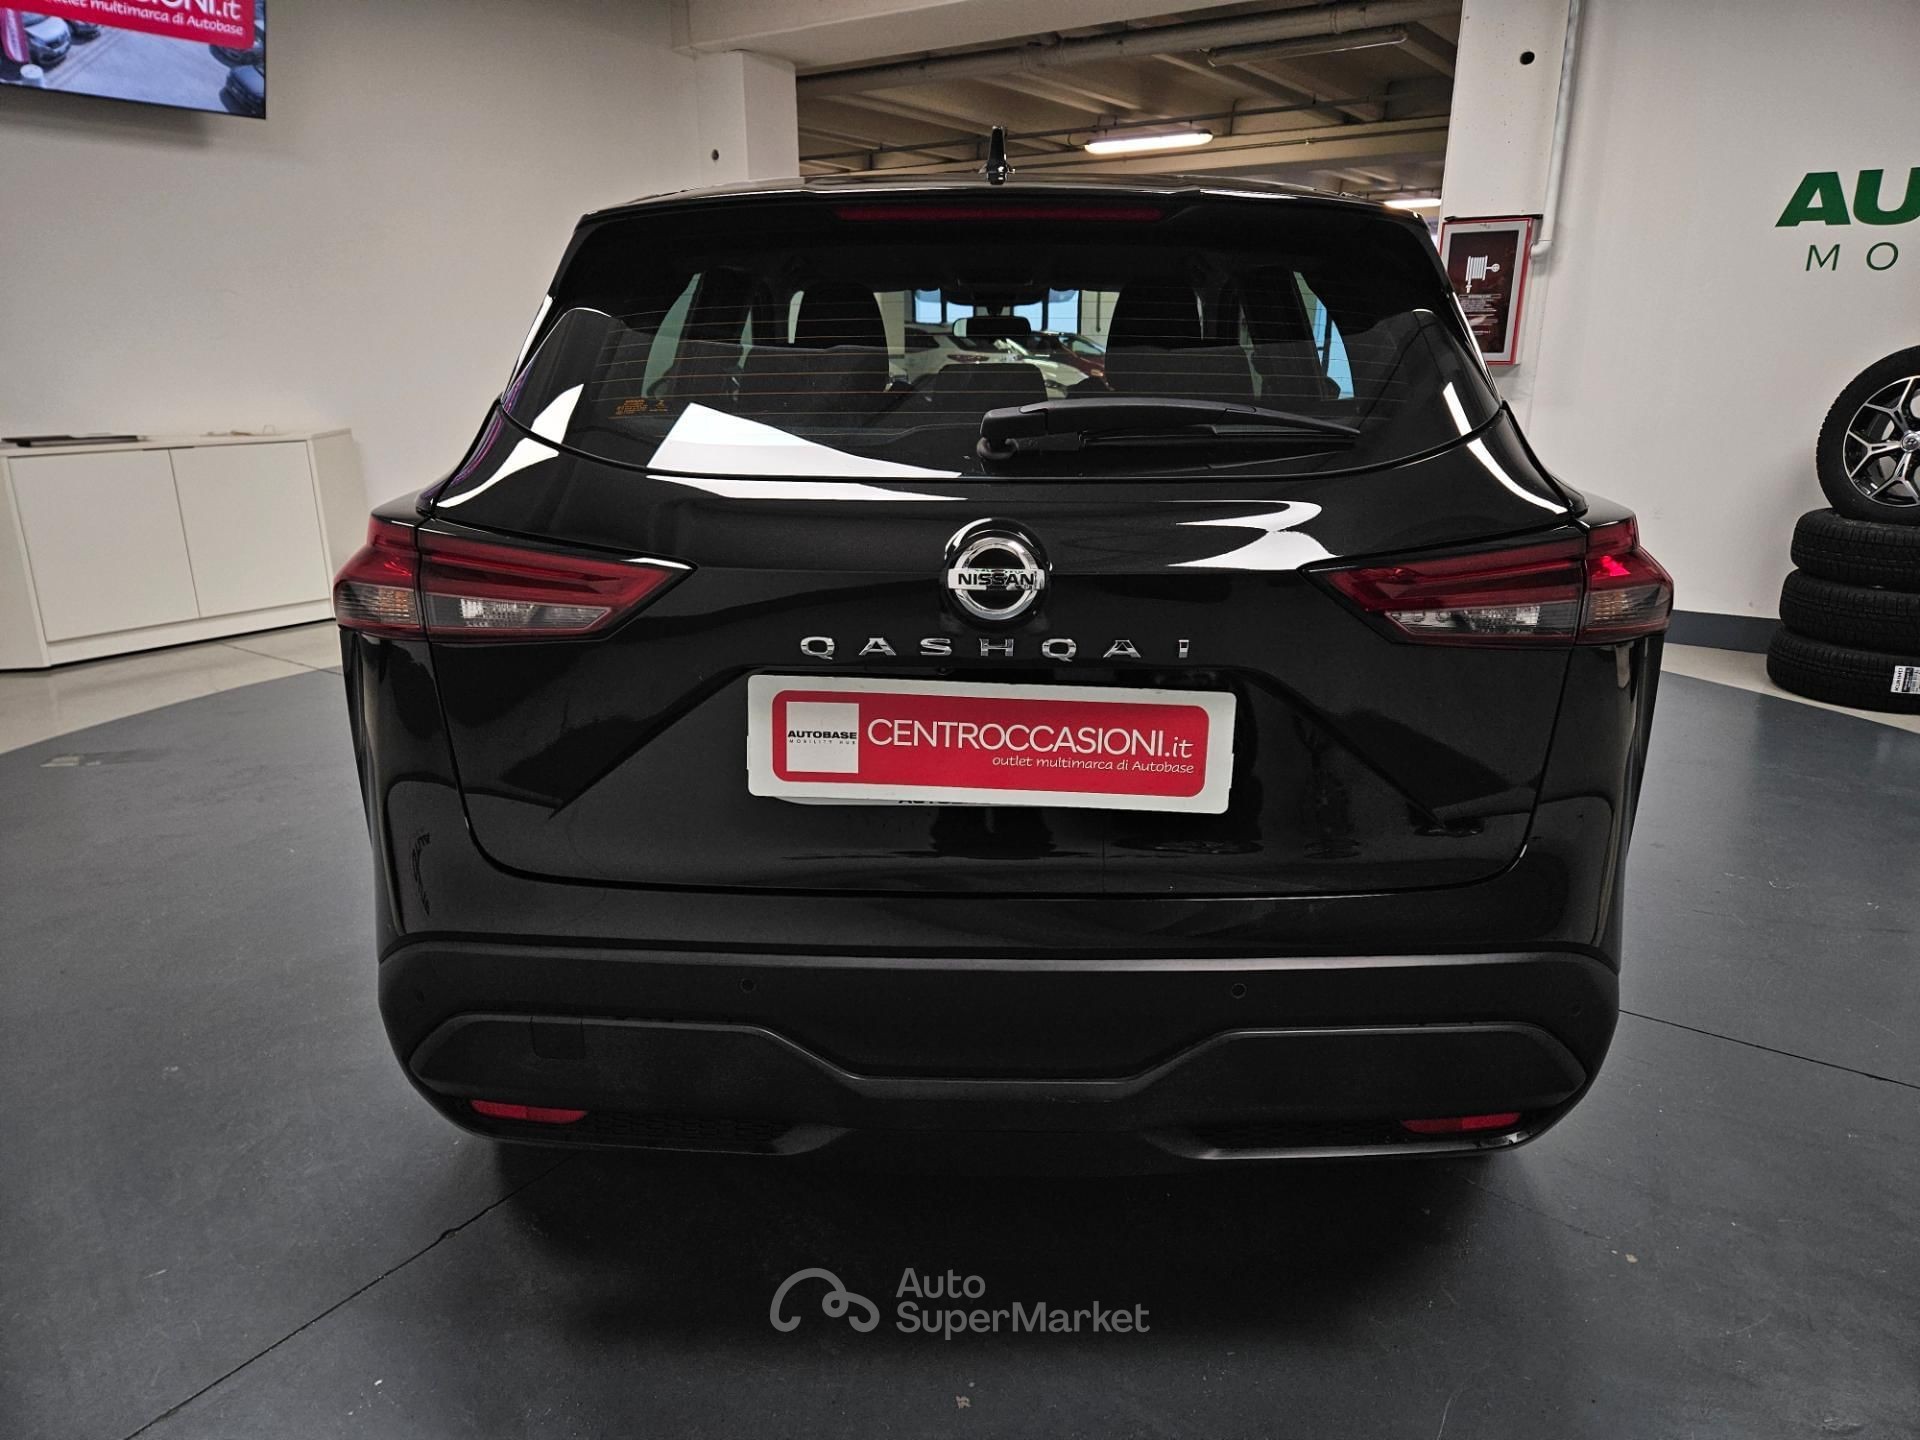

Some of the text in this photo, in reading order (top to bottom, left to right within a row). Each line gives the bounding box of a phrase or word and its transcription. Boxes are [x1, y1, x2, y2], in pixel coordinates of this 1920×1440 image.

[172, 12, 185, 25] di
[187, 15, 244, 36] Autobase
[1775, 167, 1920, 227] AU
[1806, 242, 1899, 271] MO
[958, 573, 1034, 586] NISSAN
[800, 636, 1190, 662] QASHQAI
[788, 730, 857, 740] AUTOBASE
[868, 718, 1194, 759] CENTROCCASIONI.it
[992, 755, 1195, 774] outlet multimarca di Autobase
